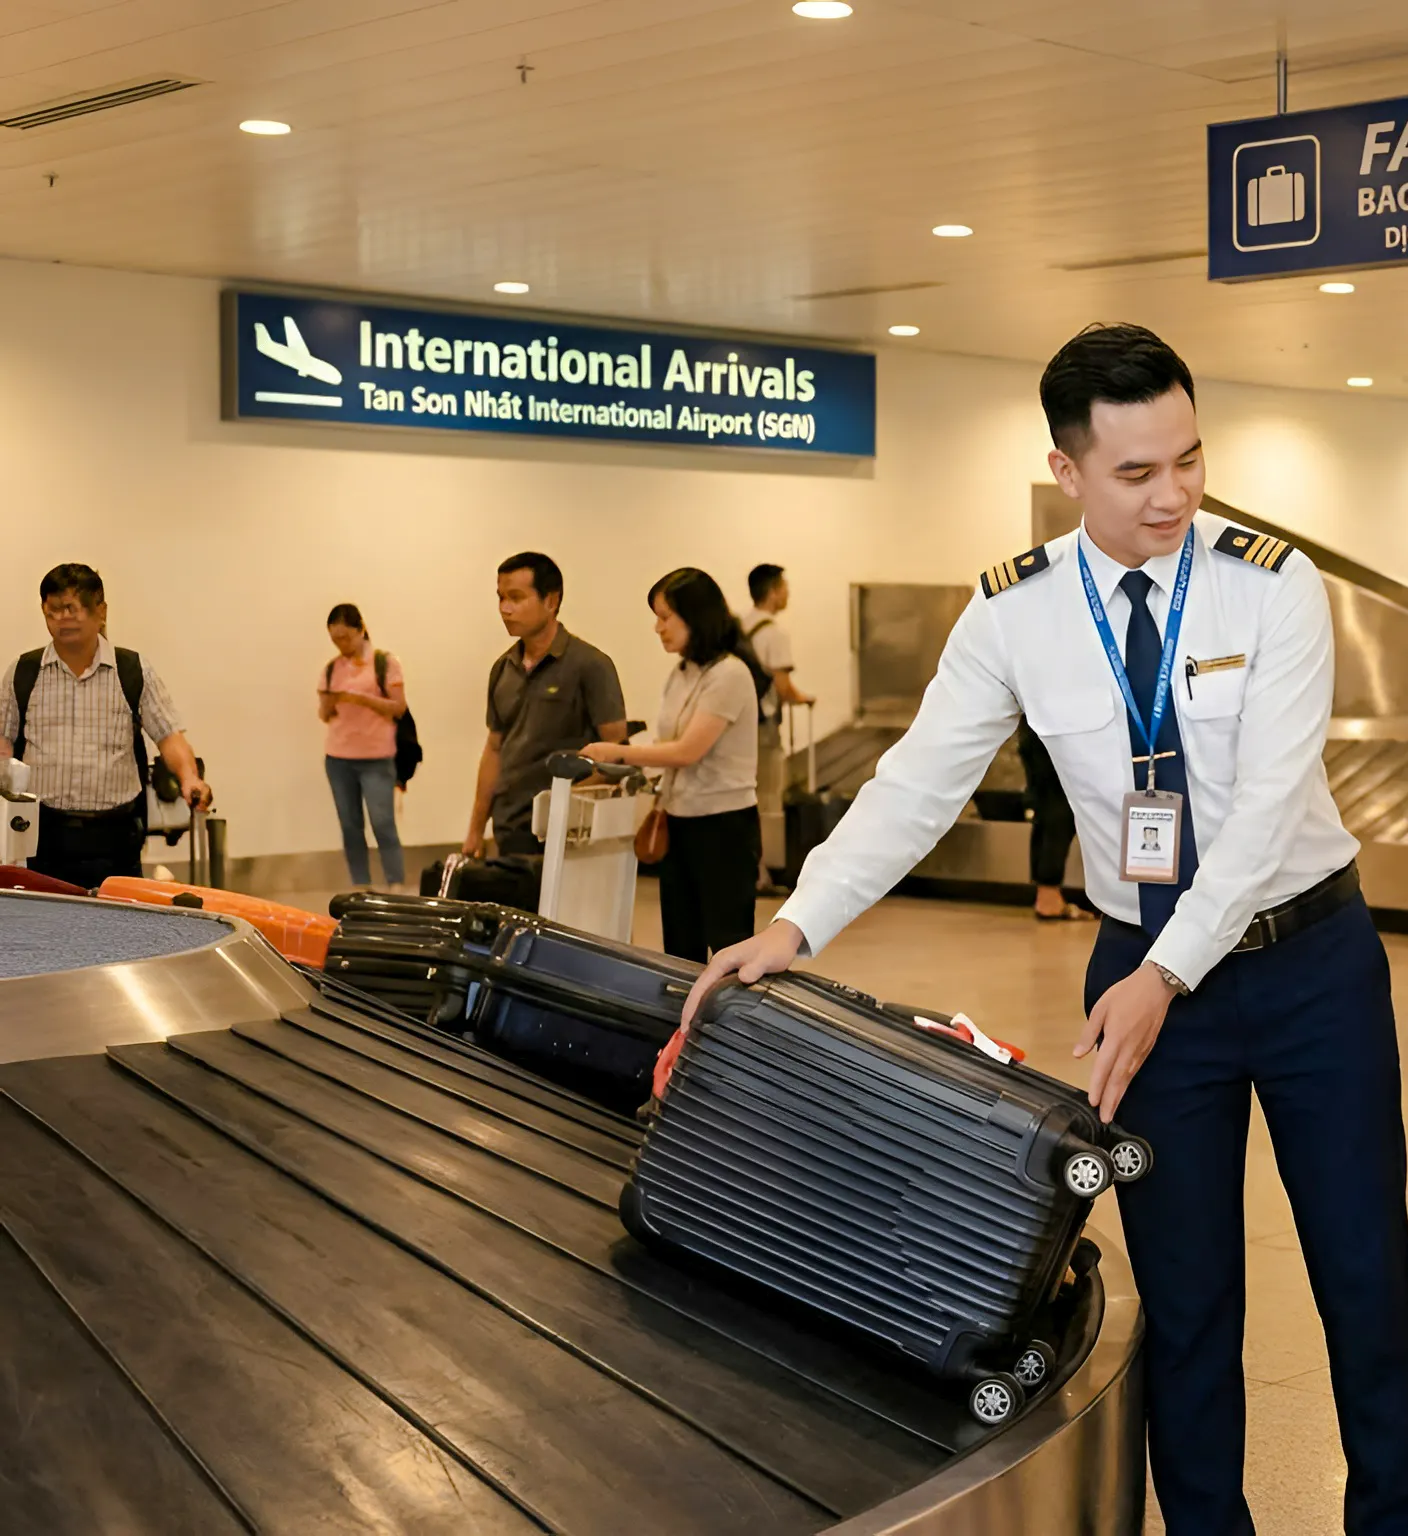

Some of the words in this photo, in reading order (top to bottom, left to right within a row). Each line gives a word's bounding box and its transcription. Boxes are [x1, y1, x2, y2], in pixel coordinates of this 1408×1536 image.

[358, 320, 652, 389] International
[662, 349, 816, 403] Arrivals
[358, 381, 405, 412] Tan
[411, 385, 458, 416] Son
[528, 394, 673, 430] International
[676, 405, 753, 439] Airport
[756, 410, 816, 445] (SGN)
